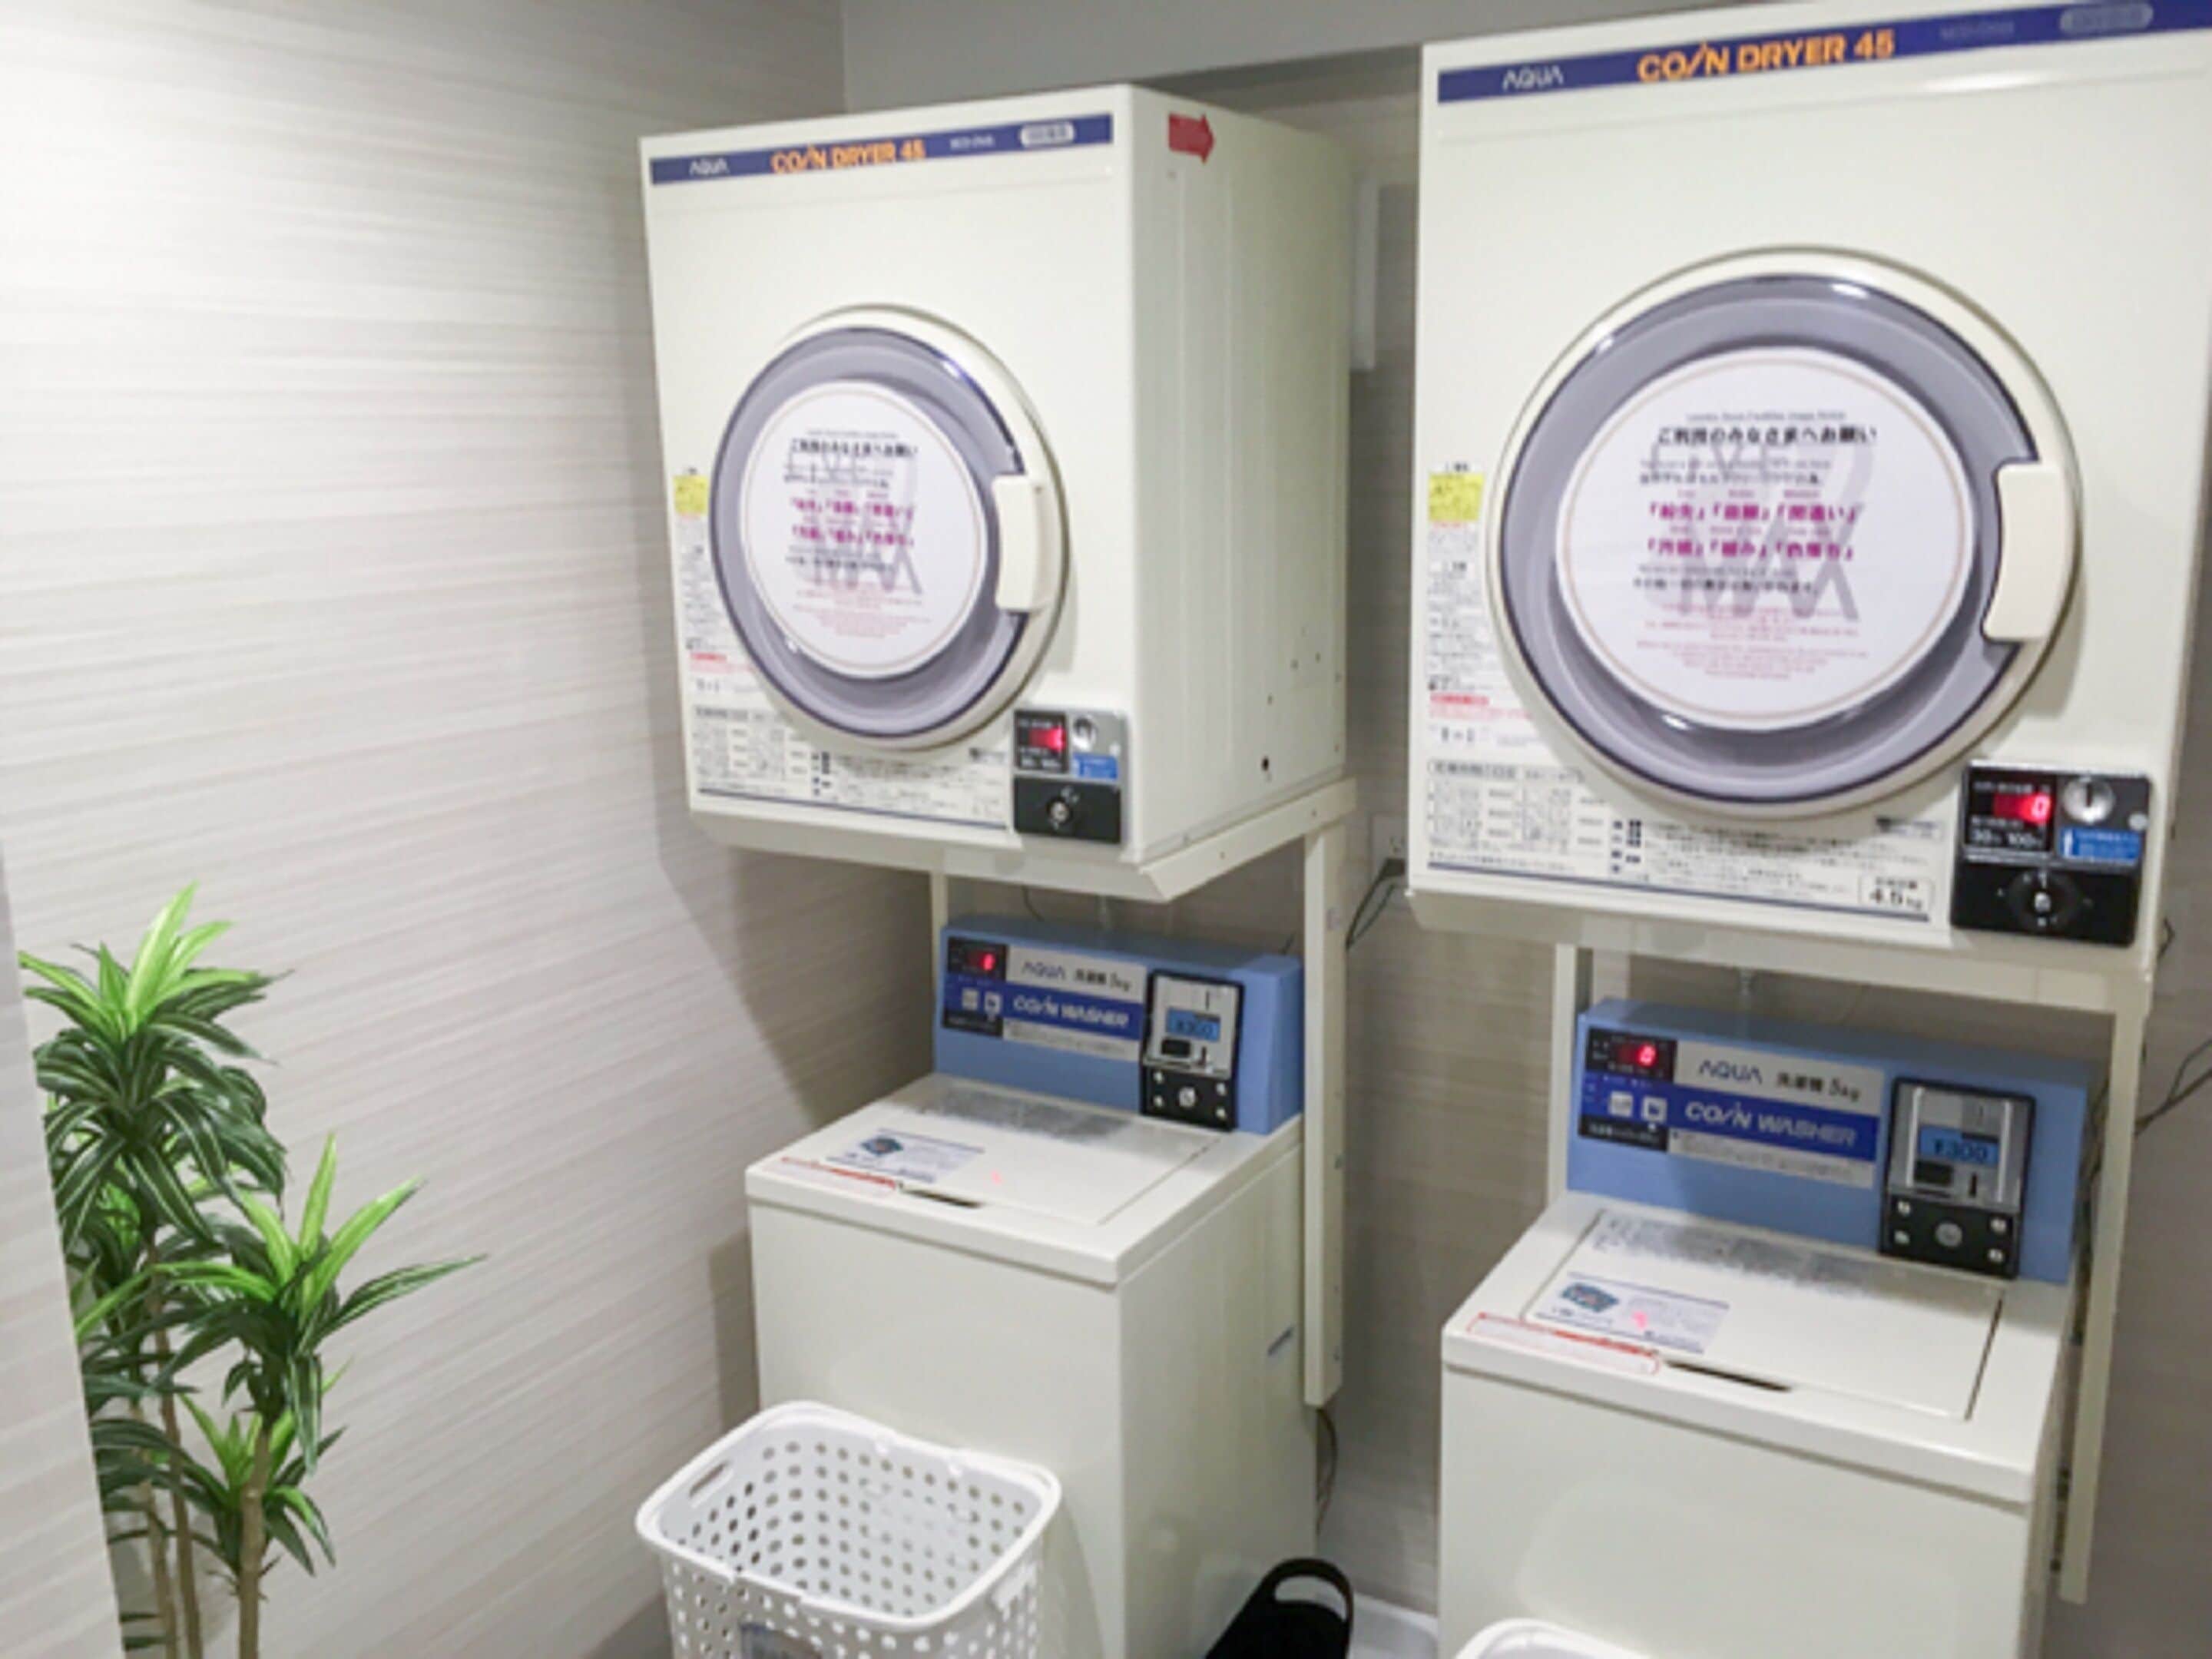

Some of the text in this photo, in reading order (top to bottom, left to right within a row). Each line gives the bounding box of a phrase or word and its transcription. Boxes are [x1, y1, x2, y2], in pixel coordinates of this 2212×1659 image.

[1738, 35, 1846, 73] DRYER
[1855, 29, 1896, 60] 45
[1503, 65, 1563, 91] AQUA
[1699, 1058, 1763, 1085] AQUA
[1758, 1114, 1856, 1147] WASHER
